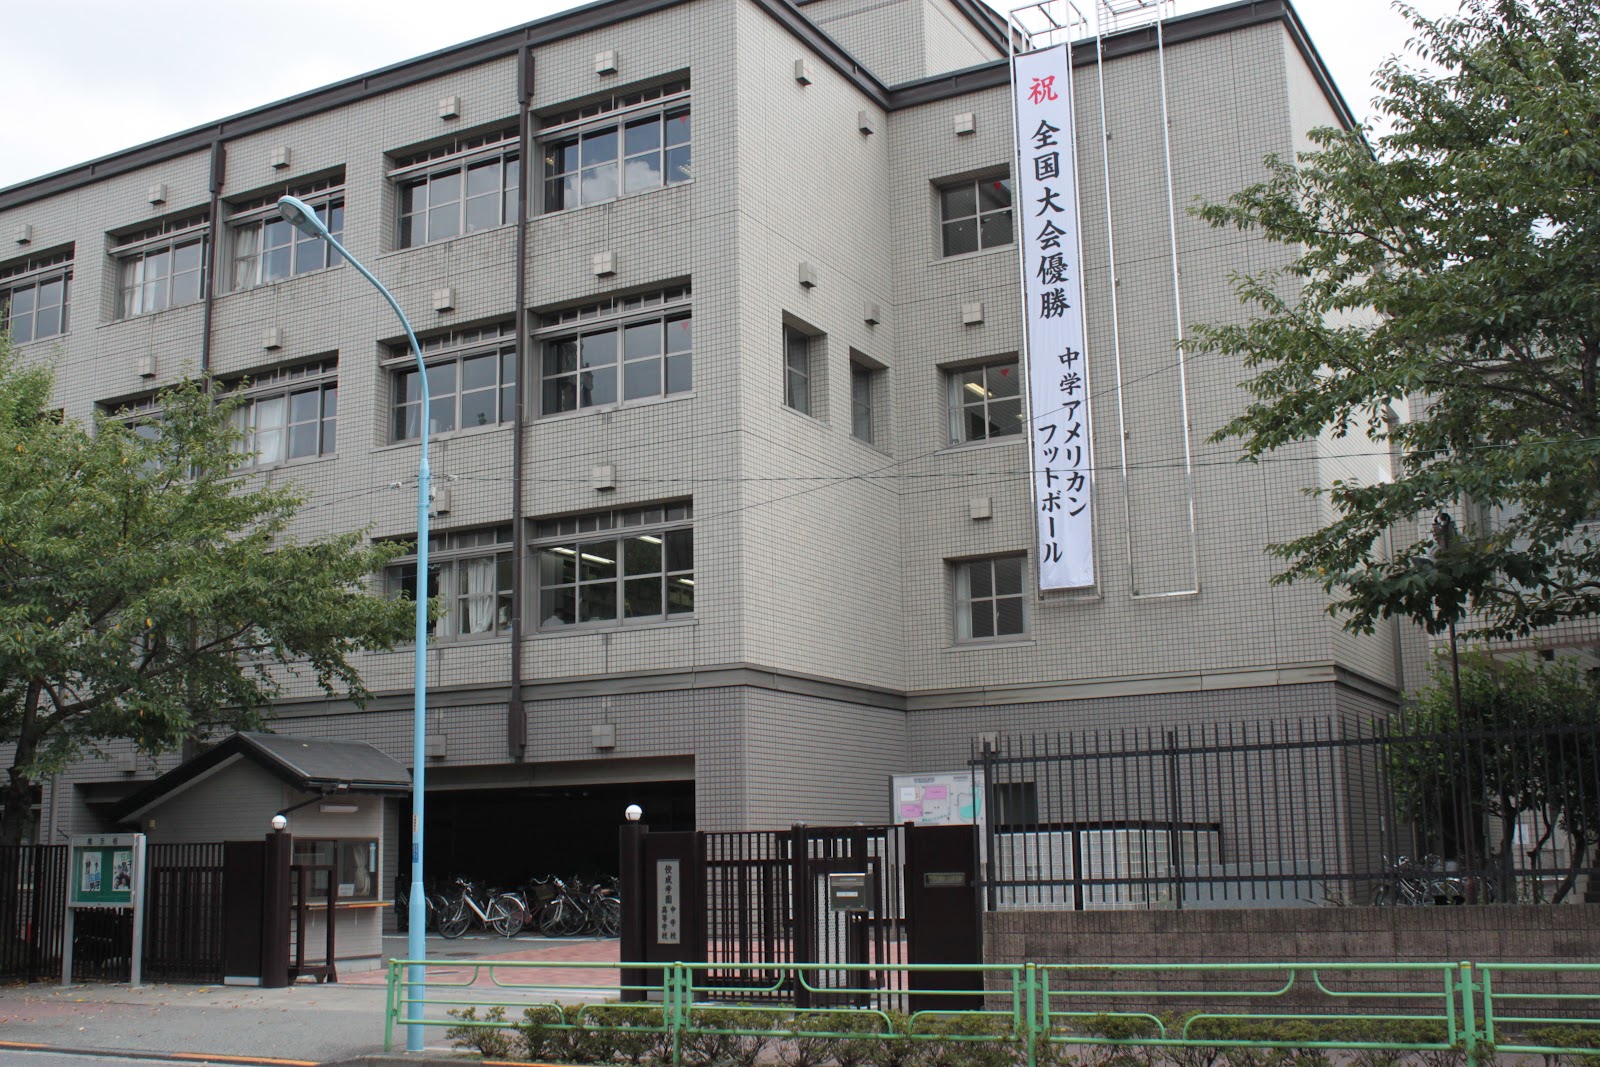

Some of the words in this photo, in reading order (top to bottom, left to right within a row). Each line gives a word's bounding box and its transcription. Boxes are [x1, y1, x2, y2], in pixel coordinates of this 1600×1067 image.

[1027, 75, 1059, 105] 祝
[1030, 119, 1071, 320] 全国大会優勝
[1038, 424, 1063, 564] フットボール
[1058, 347, 1087, 517] 中学アメリカン
